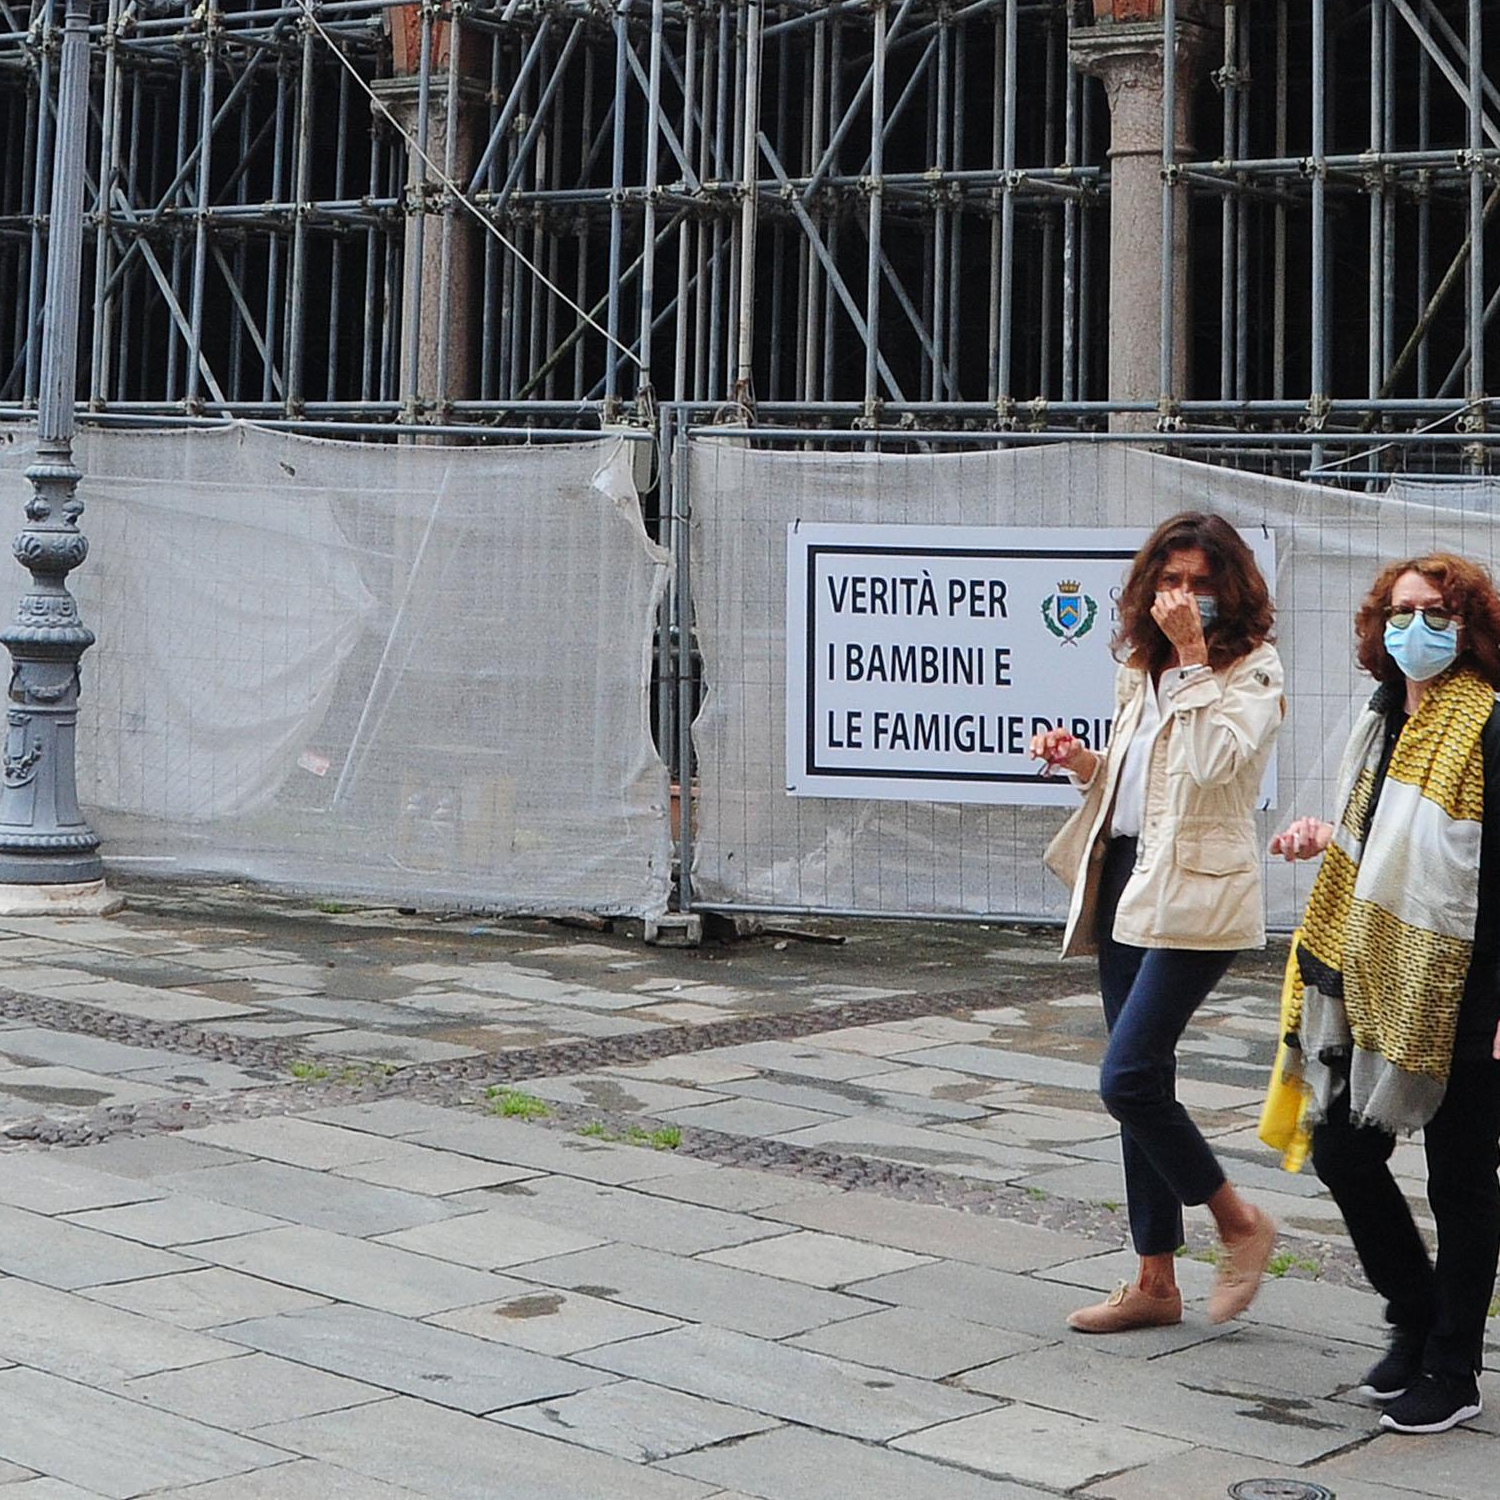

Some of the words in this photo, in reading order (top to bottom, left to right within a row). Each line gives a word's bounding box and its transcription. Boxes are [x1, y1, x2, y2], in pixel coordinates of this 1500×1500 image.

[828, 570, 939, 616] VERITÀ
[949, 579, 1008, 618] PER
[828, 643, 835, 681] I
[846, 644, 984, 685] BAMBINI
[996, 648, 1011, 686] E
[828, 711, 862, 749] LE
[873, 712, 1025, 754] FAMIGLIE
